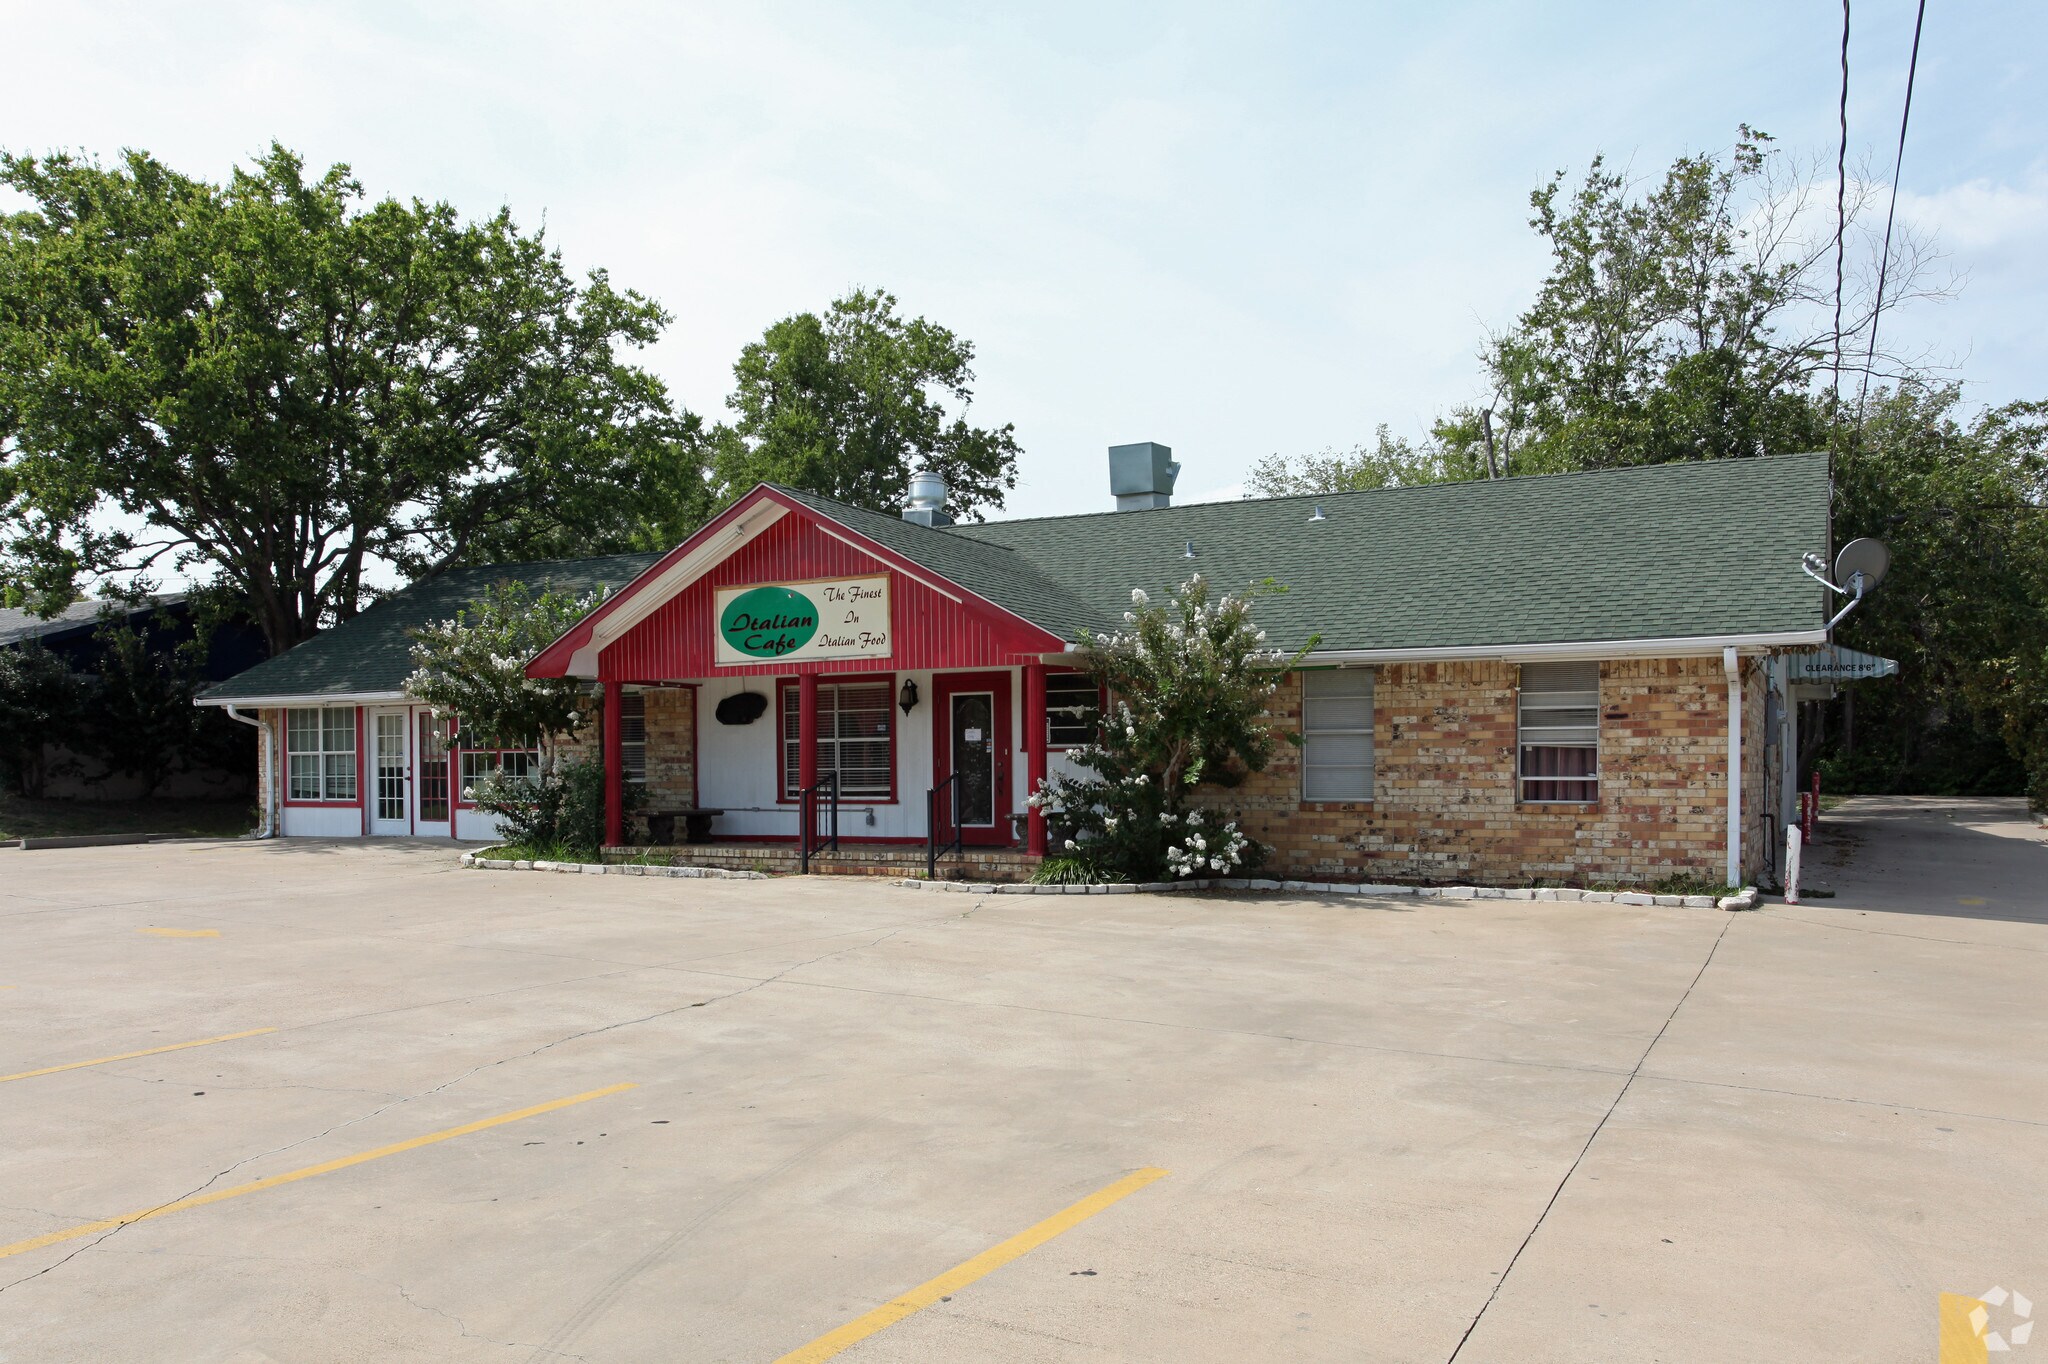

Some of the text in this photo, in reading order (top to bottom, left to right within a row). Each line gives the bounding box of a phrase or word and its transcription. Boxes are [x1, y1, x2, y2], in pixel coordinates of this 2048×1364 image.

[823, 586, 882, 603] The Finest
[727, 613, 813, 633] Italian
[844, 610, 859, 624] In
[744, 633, 796, 656] Cafe
[818, 631, 886, 649] Italian Food
[1805, 663, 1856, 672] CLEARANCE
